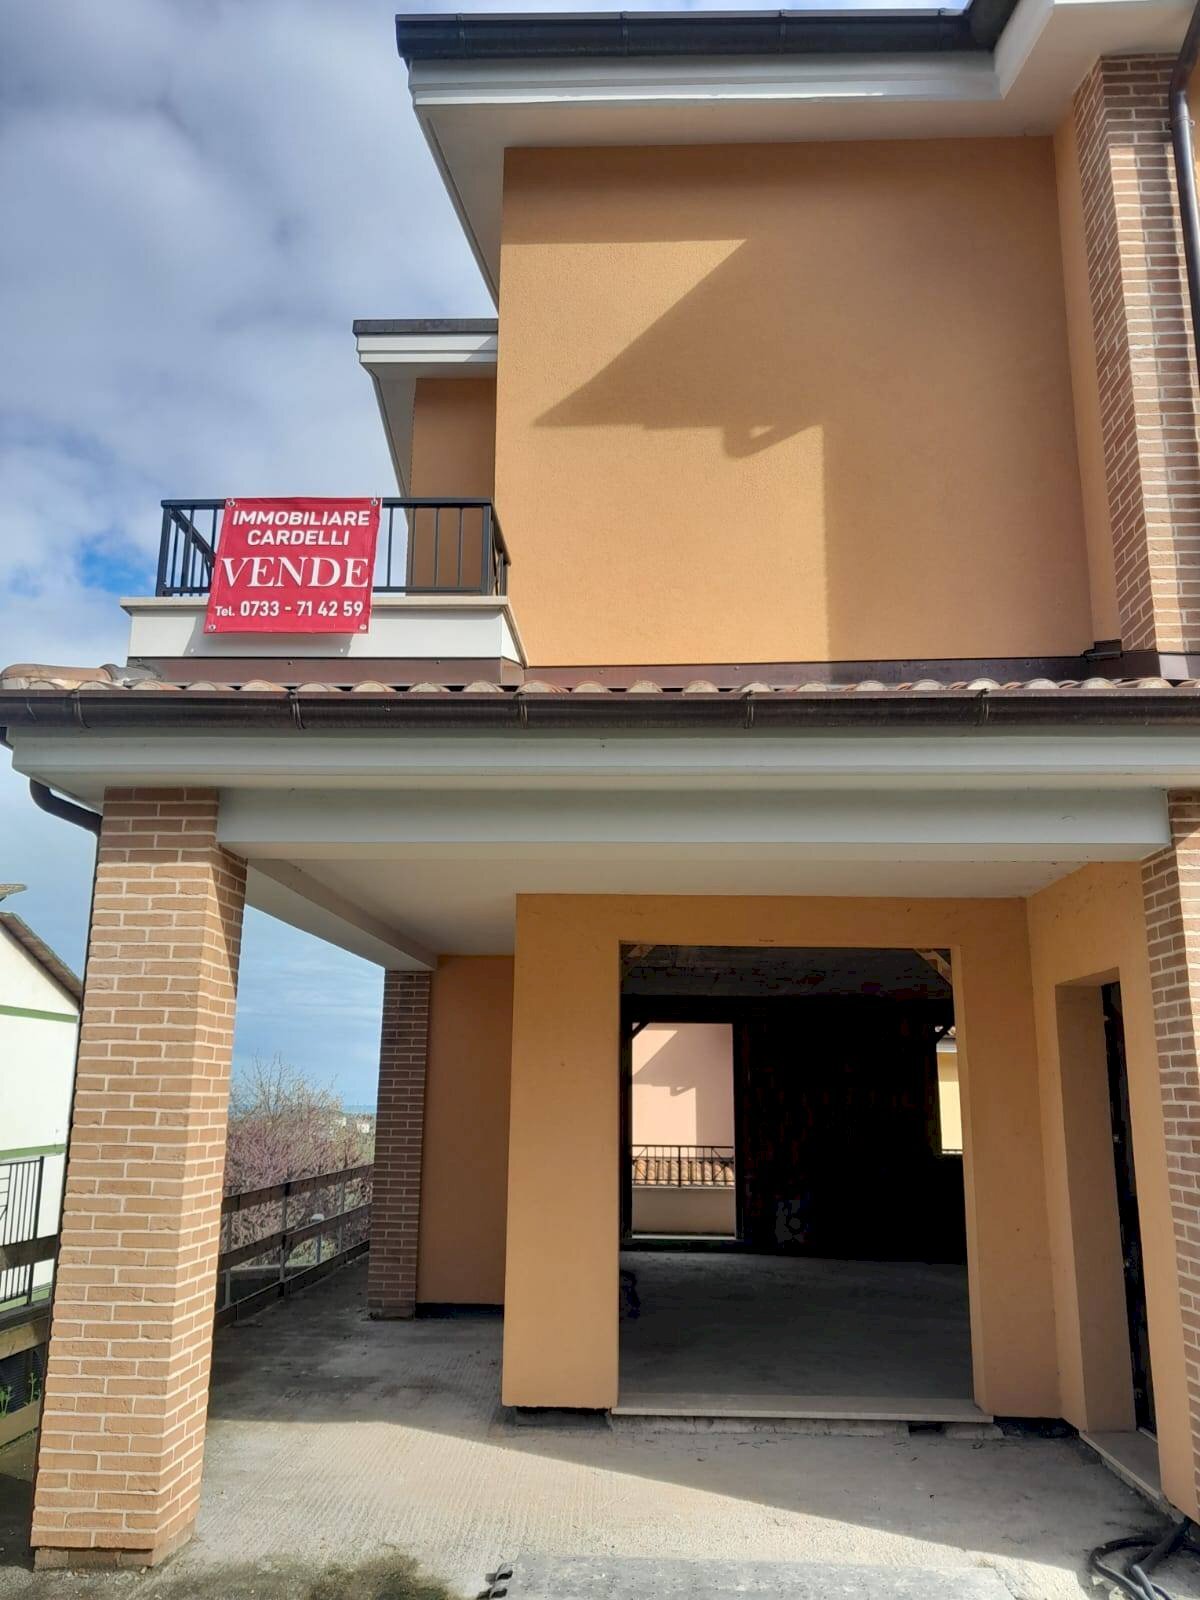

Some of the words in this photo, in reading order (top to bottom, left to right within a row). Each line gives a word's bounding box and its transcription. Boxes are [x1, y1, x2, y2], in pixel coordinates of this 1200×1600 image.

[232, 510, 370, 526] IMMOBILIARE
[247, 530, 350, 546] CARDELLI
[221, 556, 369, 588] VENDE
[215, 605, 236, 617] Tel.
[240, 601, 280, 617] 0733
[297, 601, 313, 617] 71
[317, 601, 338, 617] 42
[343, 601, 364, 617] 59
